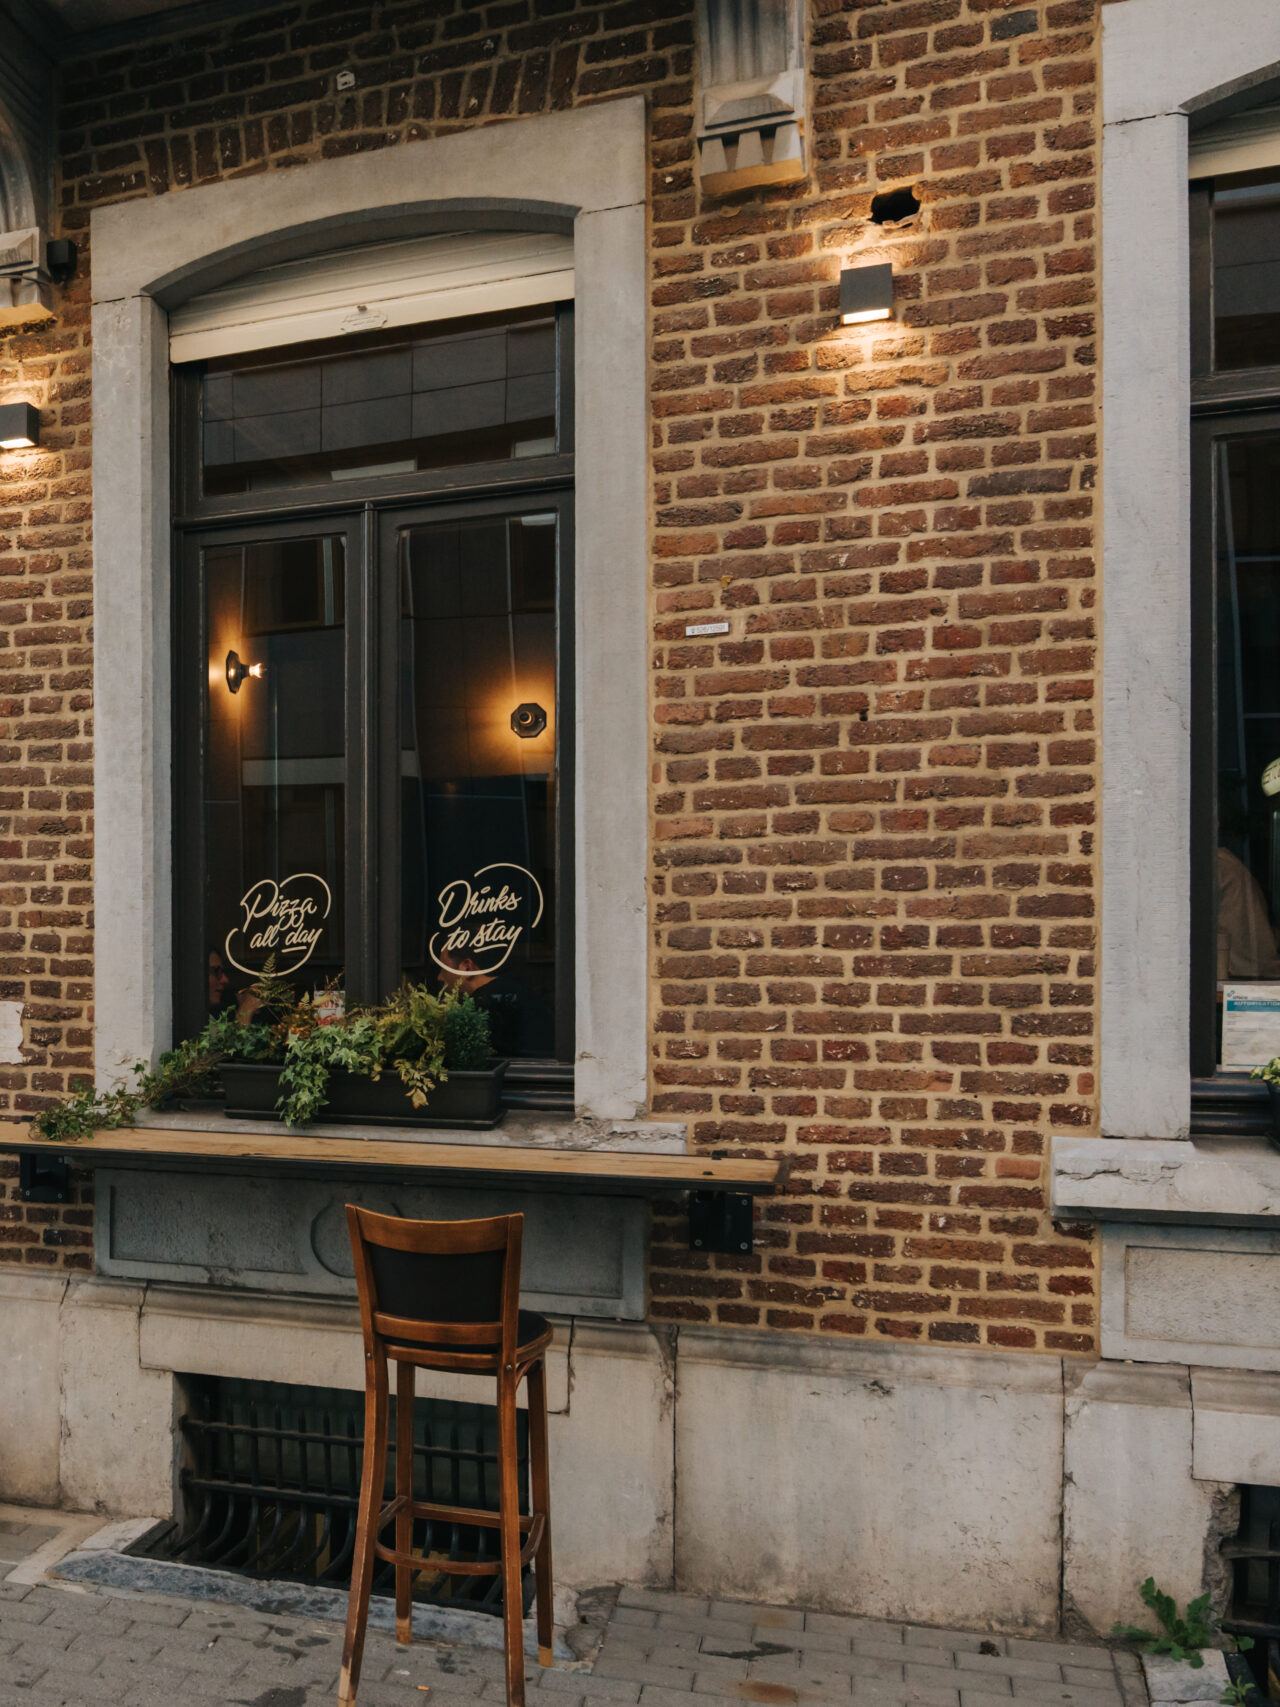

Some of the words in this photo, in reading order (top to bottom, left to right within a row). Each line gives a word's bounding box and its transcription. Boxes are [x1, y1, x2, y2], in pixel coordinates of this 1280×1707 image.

[240, 879, 318, 933] Pizza
[438, 880, 522, 928] Drinks
[250, 923, 279, 949] all
[285, 919, 324, 953] day
[441, 926, 470, 953] to
[469, 917, 523, 953] stay
